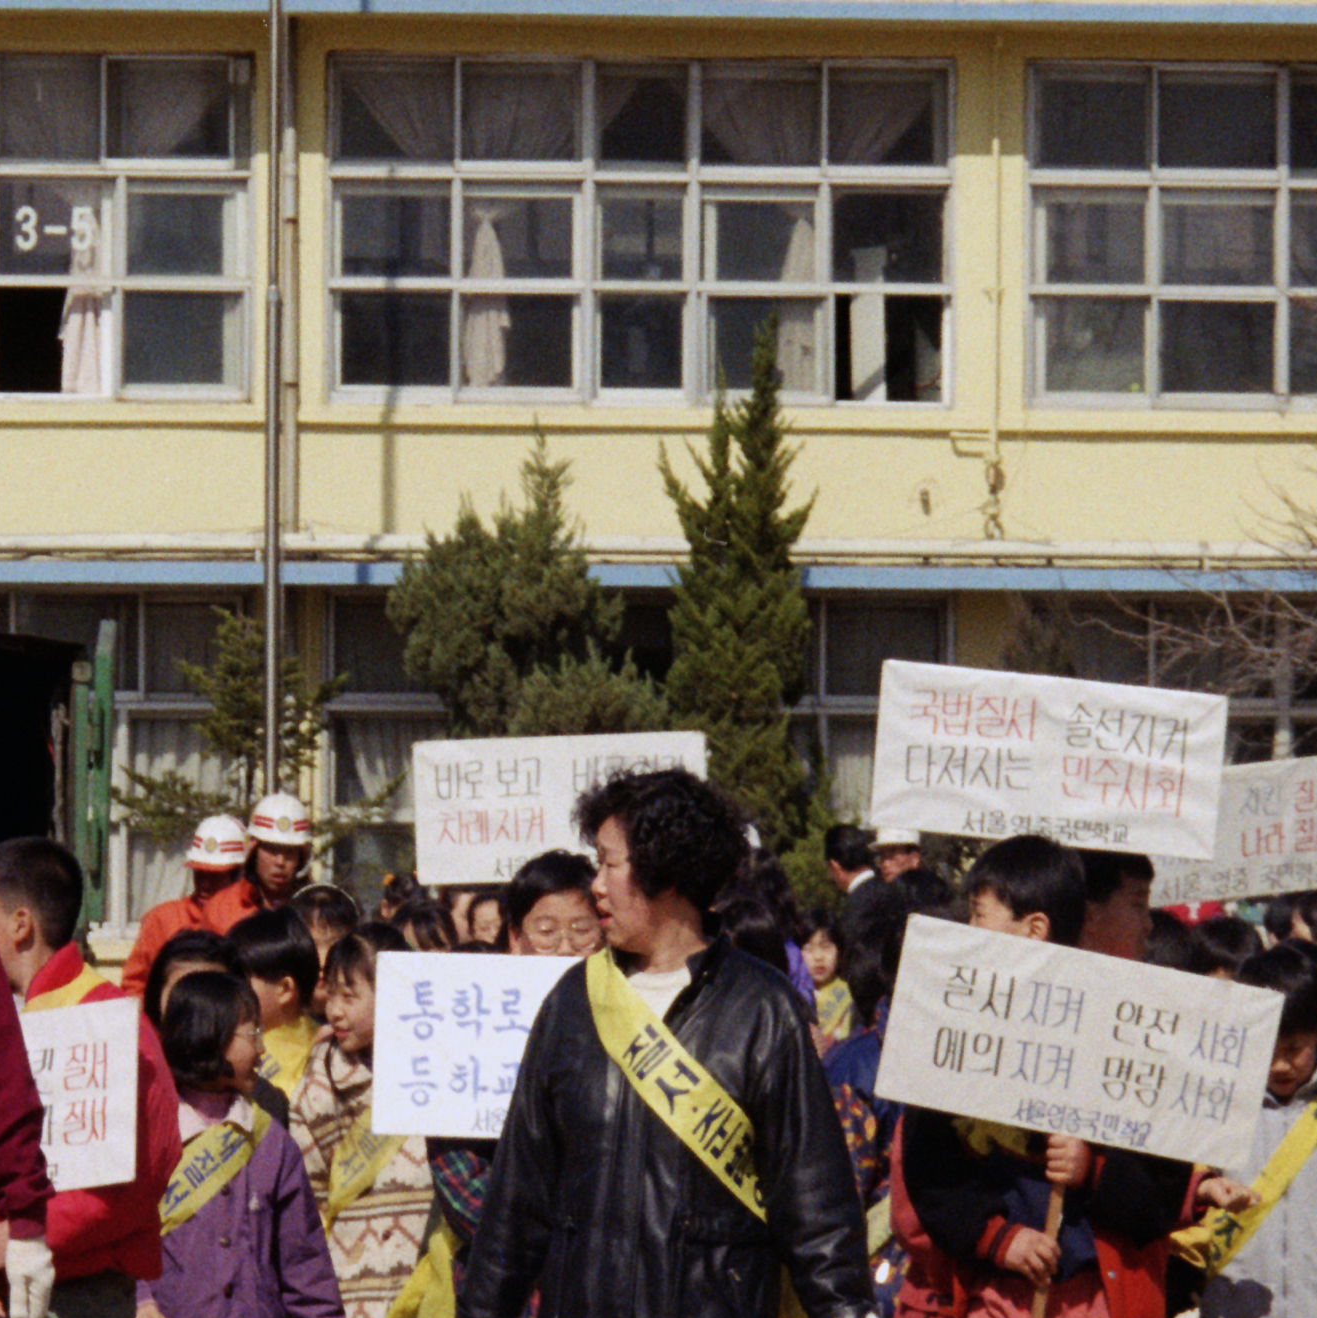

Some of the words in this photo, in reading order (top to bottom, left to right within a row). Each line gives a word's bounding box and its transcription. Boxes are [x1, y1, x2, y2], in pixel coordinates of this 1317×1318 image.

[14, 205, 96, 253] 3-5
[909, 688, 1038, 742] 국법질서
[1066, 702, 1189, 764] 솔선지켜
[433, 758, 485, 801] 바로
[496, 756, 542, 798] 보고
[904, 743, 1033, 791] 다져지는
[1062, 755, 1187, 819] 민주사회
[941, 963, 1016, 1021] 질서
[1020, 980, 1086, 1035] 지켜
[1113, 998, 1181, 1054] 안전
[1188, 1020, 1249, 1070] 사회
[63, 1041, 108, 1092] 질서
[932, 1025, 1005, 1078] 예의
[1009, 1038, 1076, 1091] 지켜
[1100, 1056, 1168, 1110] 명랑
[1169, 1071, 1238, 1125] 사회
[62, 1096, 108, 1147] 질서
